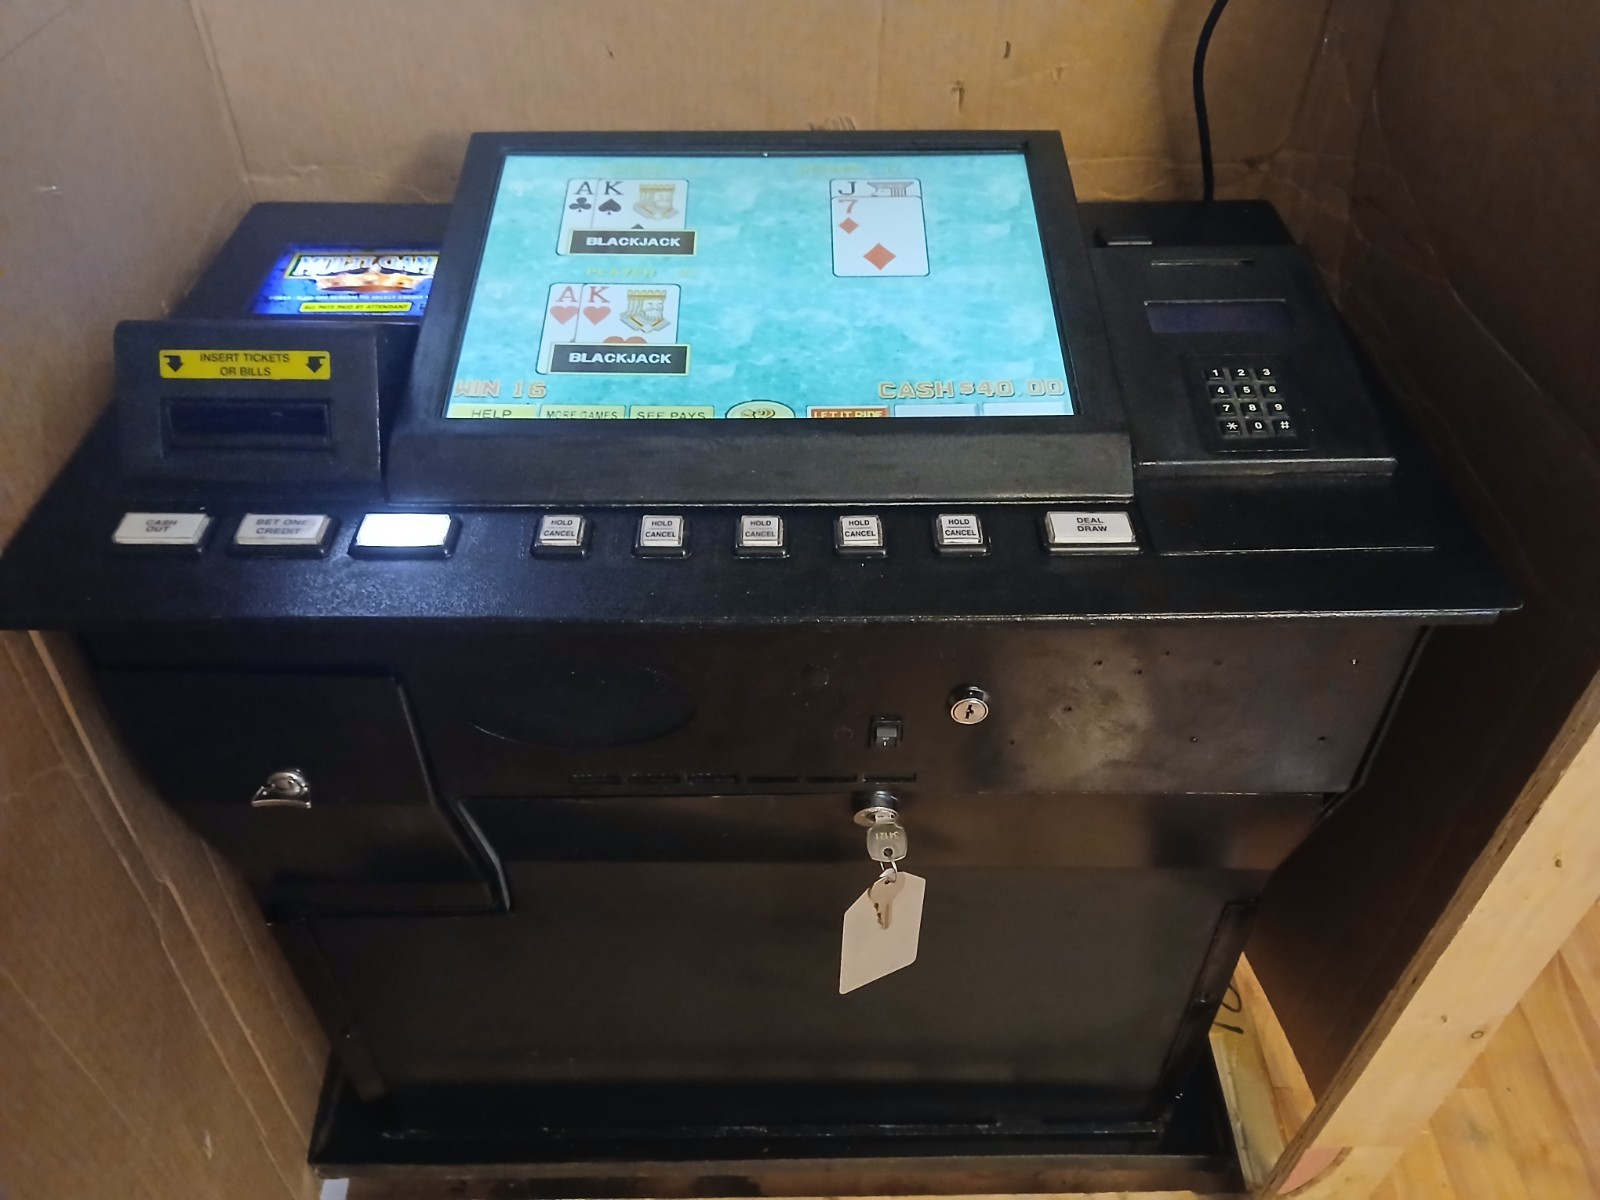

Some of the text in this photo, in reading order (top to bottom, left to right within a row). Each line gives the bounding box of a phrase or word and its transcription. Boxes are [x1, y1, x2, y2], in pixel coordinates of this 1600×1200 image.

[574, 181, 624, 195] A K
[838, 181, 855, 196] J
[838, 199, 858, 214] 7
[586, 236, 681, 248] BLACKJACK
[558, 286, 611, 303] A K
[200, 353, 290, 363] INSERT TICKETS
[569, 352, 672, 364] BLACKJACK
[219, 367, 271, 377] OR BILLS
[453, 381, 547, 398] WIN 16
[878, 381, 955, 399] CASH
[471, 409, 512, 419] HELP
[580, 410, 618, 419] GAMES
